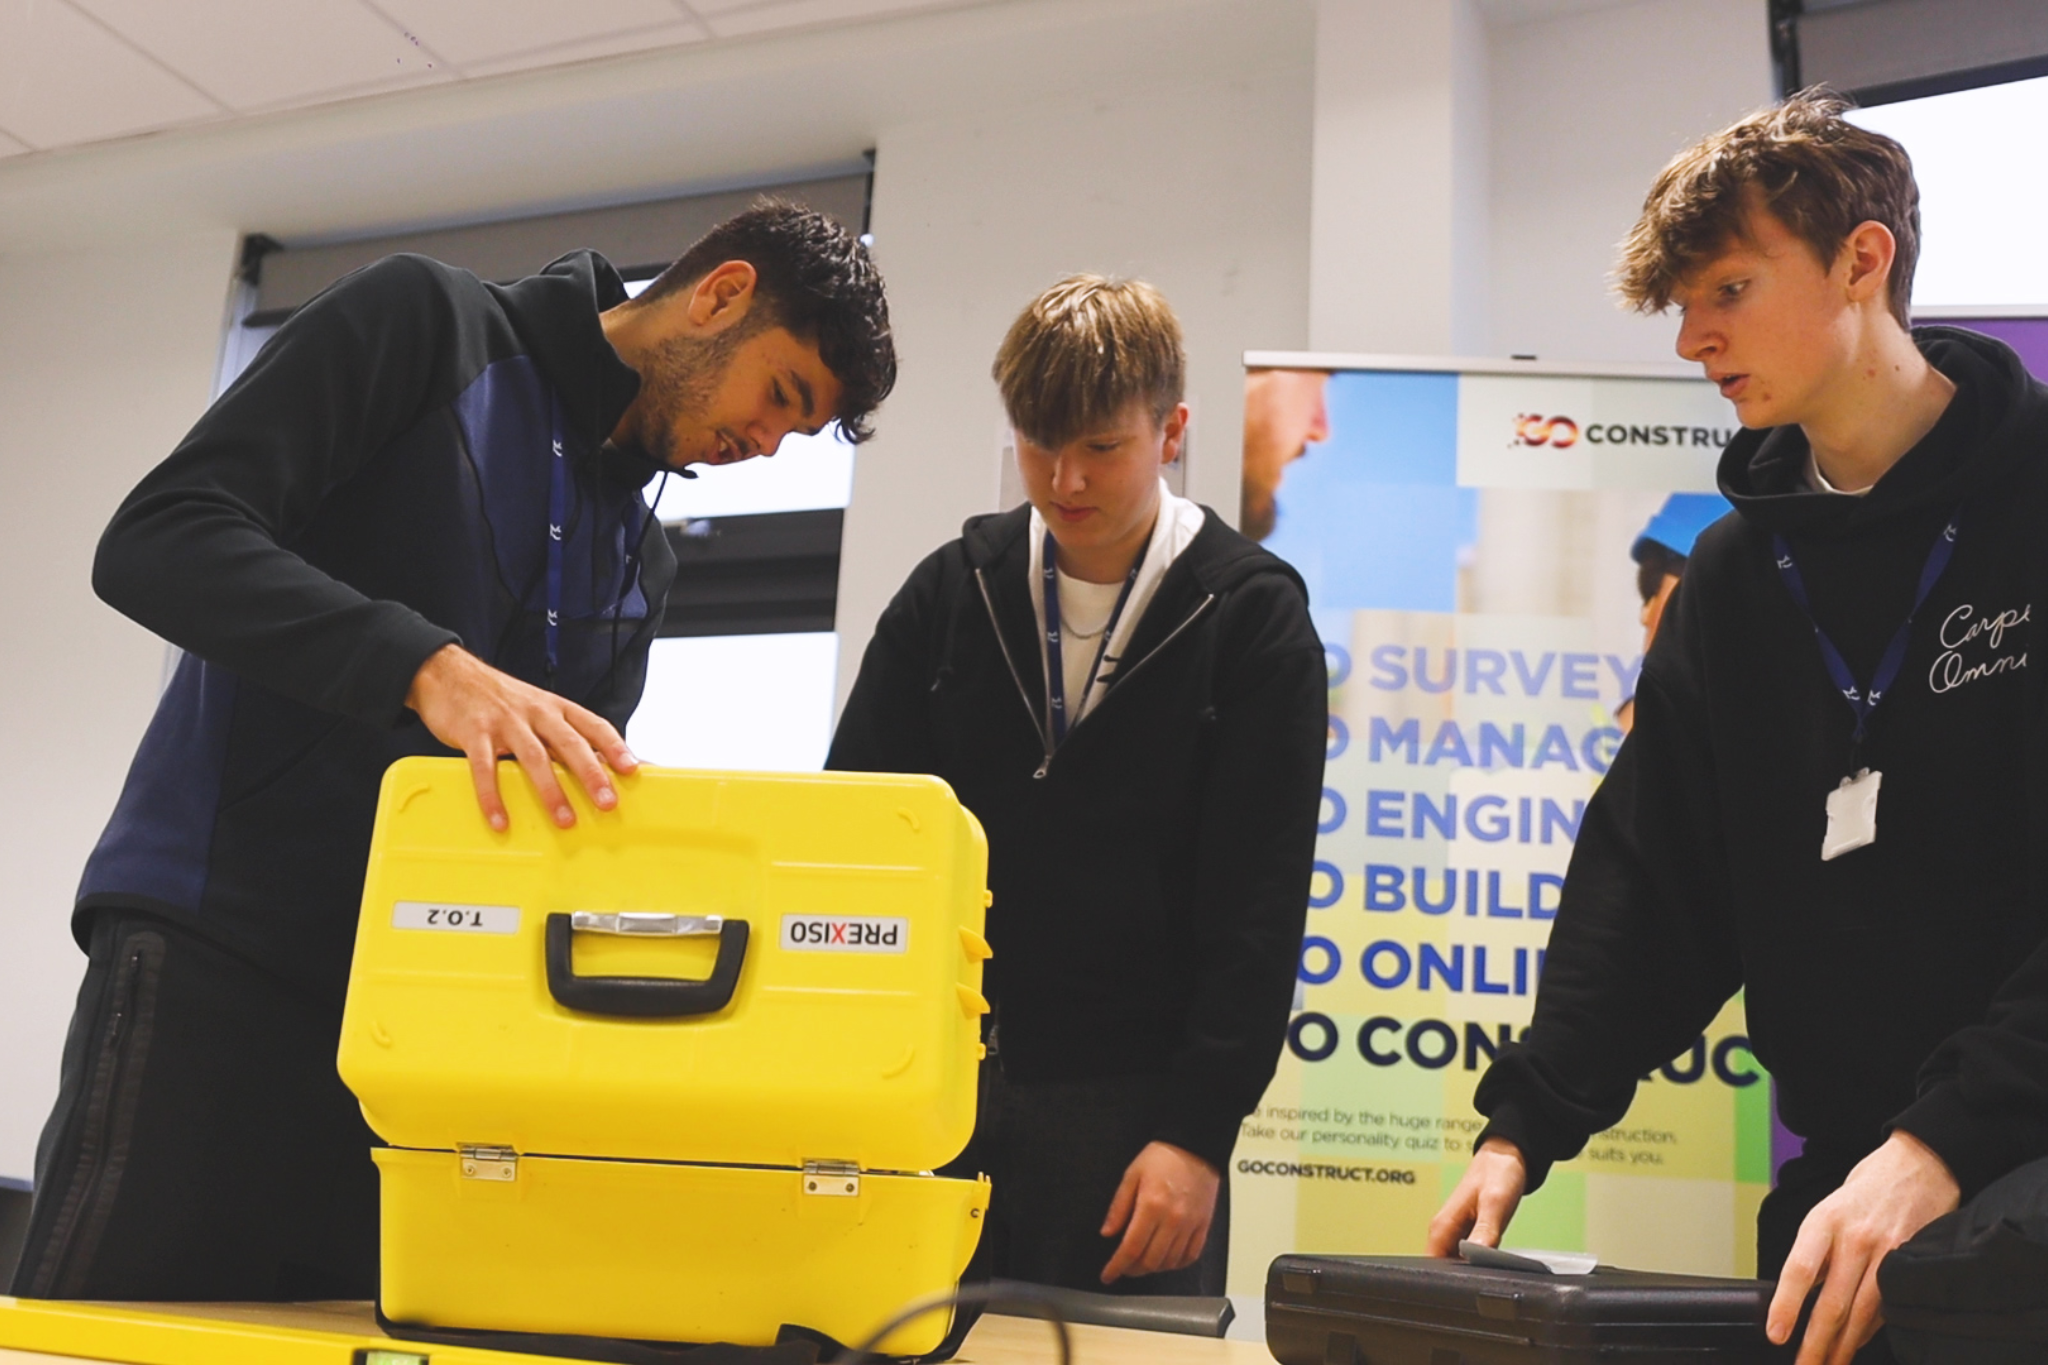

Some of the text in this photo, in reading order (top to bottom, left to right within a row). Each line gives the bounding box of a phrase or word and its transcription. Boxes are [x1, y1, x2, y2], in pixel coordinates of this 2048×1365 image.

[1586, 424, 1731, 448] CONSTRU
[1369, 645, 1645, 699] SURVEY
[1368, 716, 1623, 775] MANAG
[1366, 790, 1586, 844] ENGIN
[1364, 864, 1565, 920] BUILD
[790, 921, 898, 945] PREXISO
[1361, 940, 1545, 996] ONLI
[1241, 1123, 1275, 1140] Take
[1280, 1129, 1306, 1141] our
[1311, 1128, 1399, 1149] personality
[1405, 1136, 1438, 1151] quiz
[1444, 1136, 1460, 1151] to
[1588, 1146, 1625, 1162] suits
[1266, 1106, 1330, 1123] inspired
[1333, 1107, 1353, 1124] by
[1358, 1110, 1384, 1126] the
[1389, 1113, 1430, 1133] huge
[1436, 1118, 1482, 1134] range
[1237, 1159, 1416, 1185] GOCONSTRUCT.ORG
